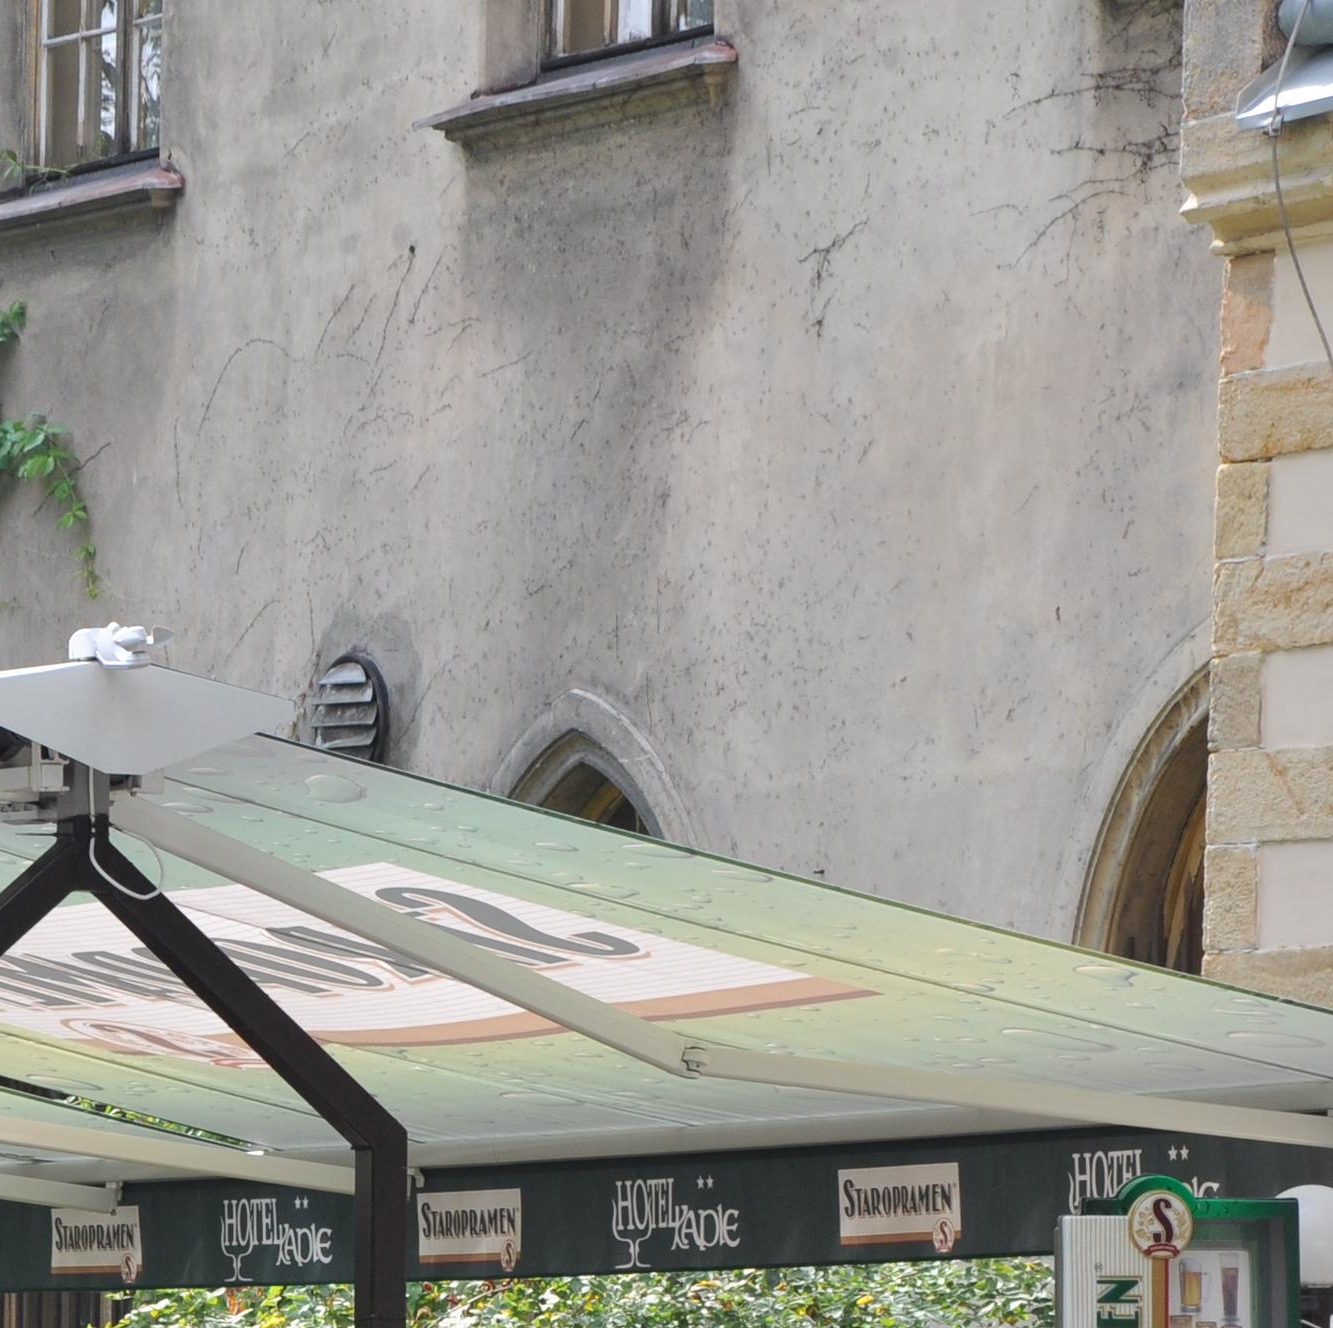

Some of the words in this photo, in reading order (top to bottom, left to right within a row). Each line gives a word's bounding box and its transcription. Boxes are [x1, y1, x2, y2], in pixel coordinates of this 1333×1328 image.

[615, 1178, 676, 1230] HOTEL
[843, 1179, 953, 1218] STAROPRAMEN
[55, 1217, 135, 1251] STAROPRAMEN
[223, 1198, 280, 1246] HOTEL
[421, 1202, 516, 1239] STAROPRAMEN
